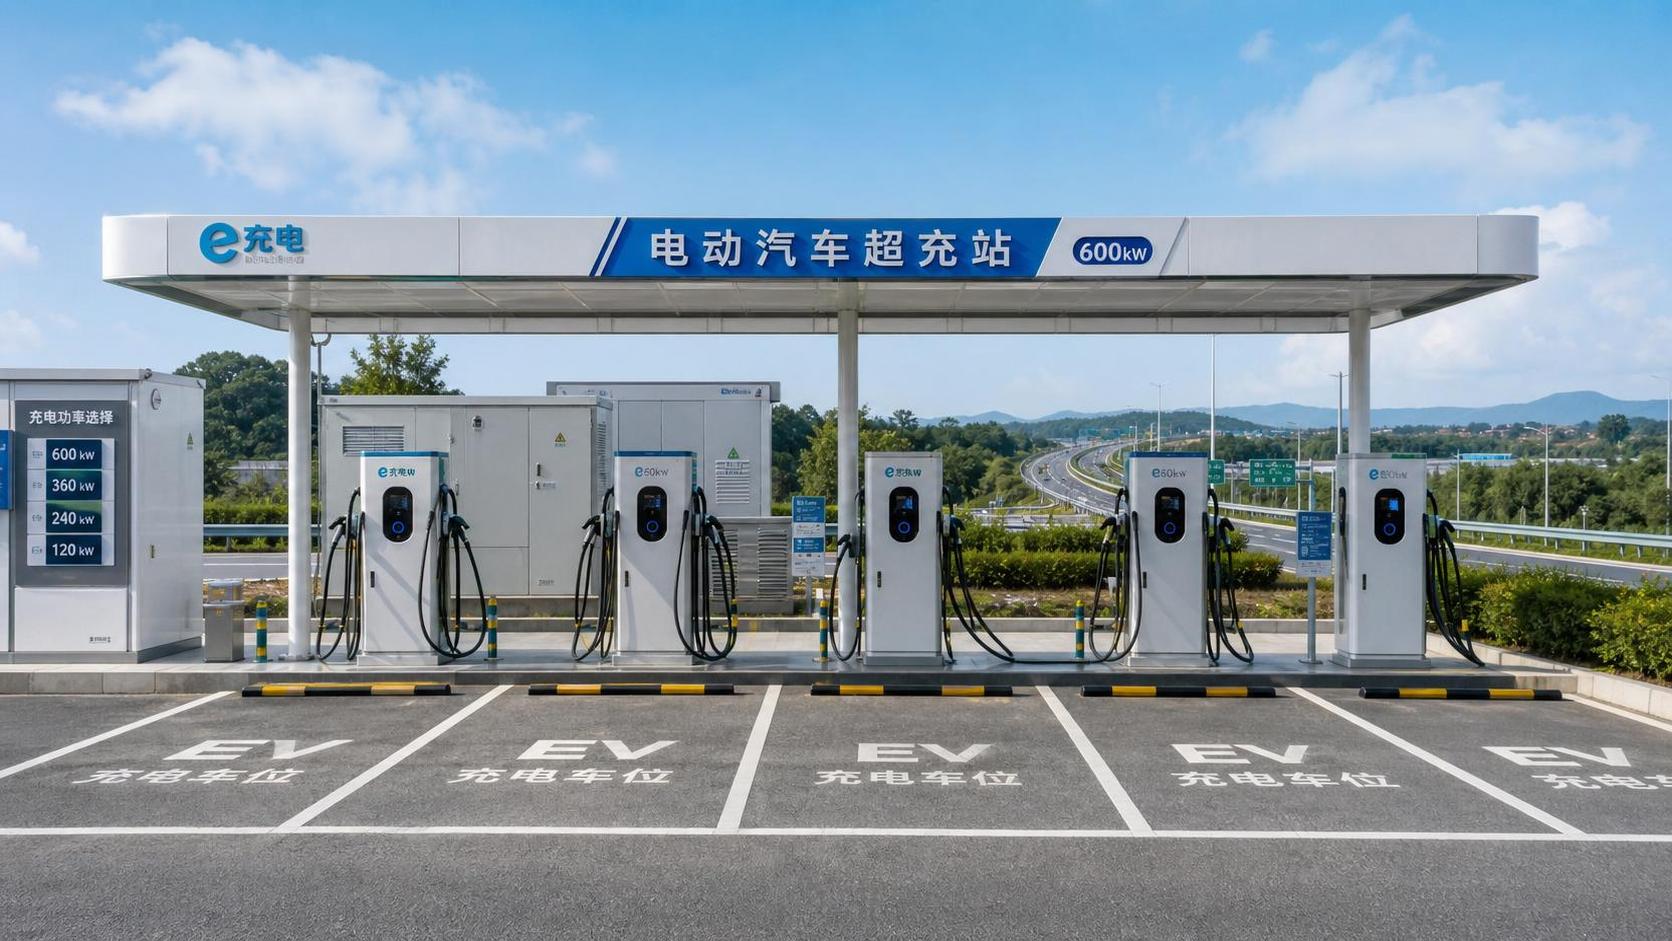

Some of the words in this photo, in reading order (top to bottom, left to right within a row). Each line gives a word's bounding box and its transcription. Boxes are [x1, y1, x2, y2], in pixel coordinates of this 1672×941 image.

[650, 228, 1013, 267] 电动汽车超充站
[29, 410, 115, 425] 充电功率选择
[52, 447, 77, 461] 600
[52, 478, 77, 492] 360
[52, 511, 77, 525] 240
[52, 543, 77, 557] 120
[163, 739, 354, 761] EV
[516, 739, 679, 761] EV
[857, 743, 993, 763] EV
[1171, 743, 1310, 764] EV
[1482, 745, 1633, 767] EV
[72, 768, 306, 784] 充电车位
[447, 767, 675, 784] 充电车位
[815, 769, 1023, 786] 充电车位
[1171, 771, 1402, 788] 充电车位
